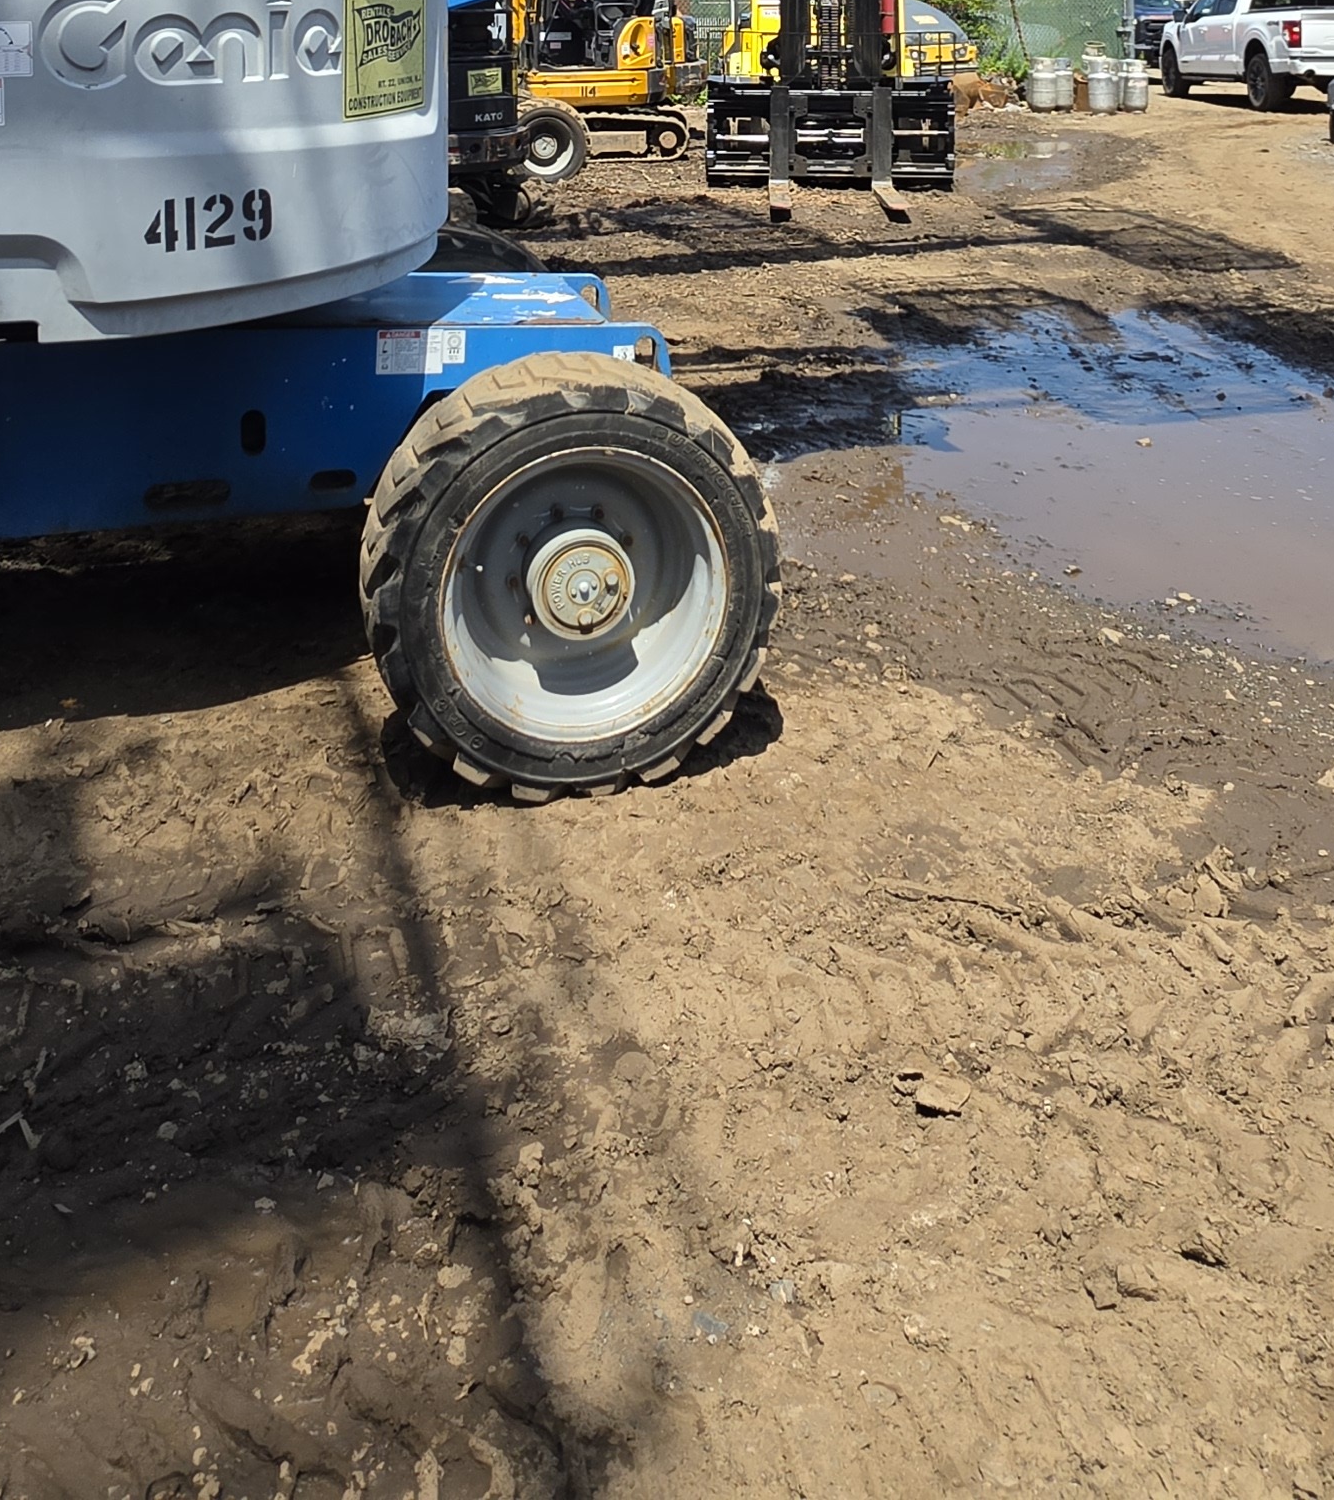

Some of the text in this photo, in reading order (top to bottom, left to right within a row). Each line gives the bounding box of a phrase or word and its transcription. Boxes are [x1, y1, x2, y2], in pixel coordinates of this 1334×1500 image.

[366, 18, 413, 47] DROBACH
[362, 45, 388, 64] SALES
[348, 92, 396, 111] CONSTRUCTION
[581, 86, 597, 98] 114
[475, 112, 503, 122] KATO
[144, 188, 273, 252] 4129
[551, 569, 566, 611] POWER
